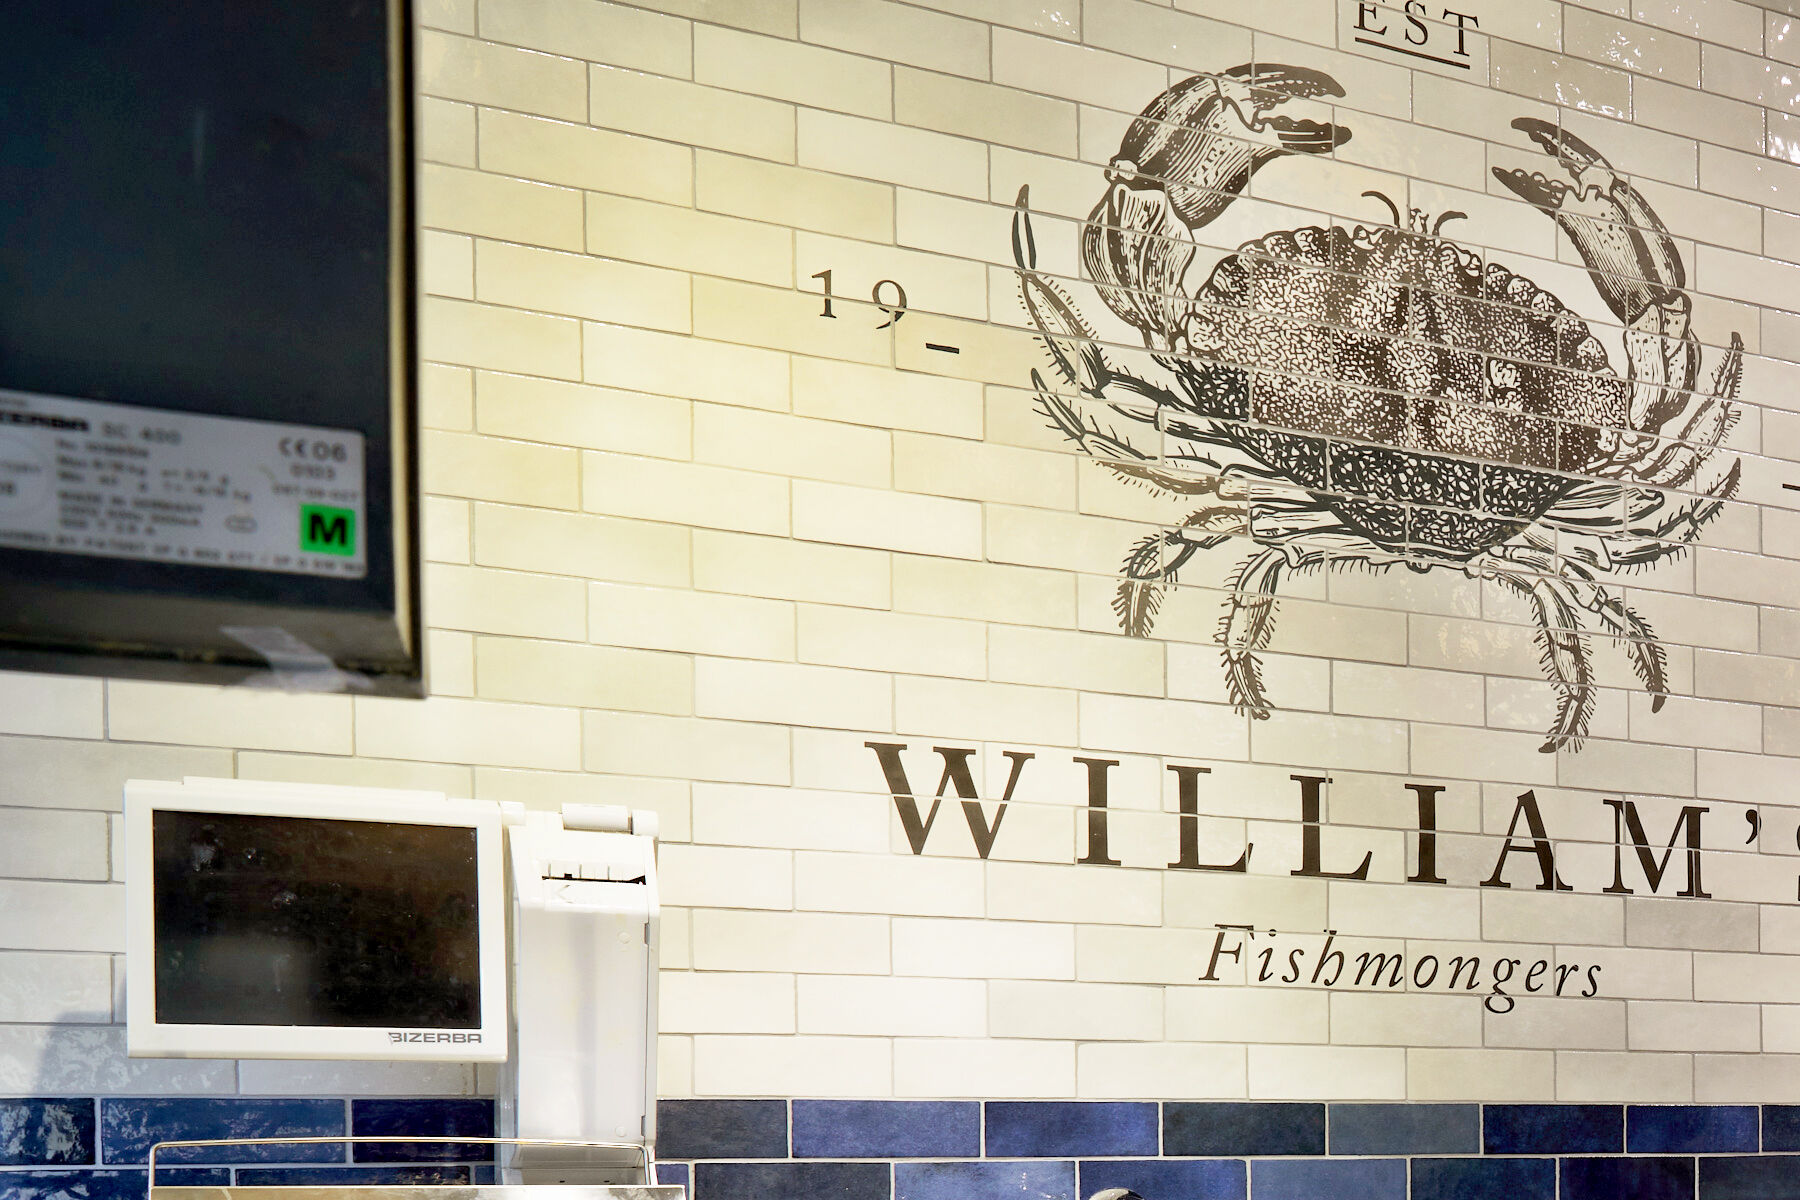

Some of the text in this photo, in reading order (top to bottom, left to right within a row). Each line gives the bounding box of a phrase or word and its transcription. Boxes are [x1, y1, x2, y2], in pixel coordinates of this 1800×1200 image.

[1353, 0, 1480, 58] EST
[309, 512, 348, 547] M
[1198, 923, 1603, 1014] Fishmongers
[388, 1032, 482, 1044] BIZERBA
